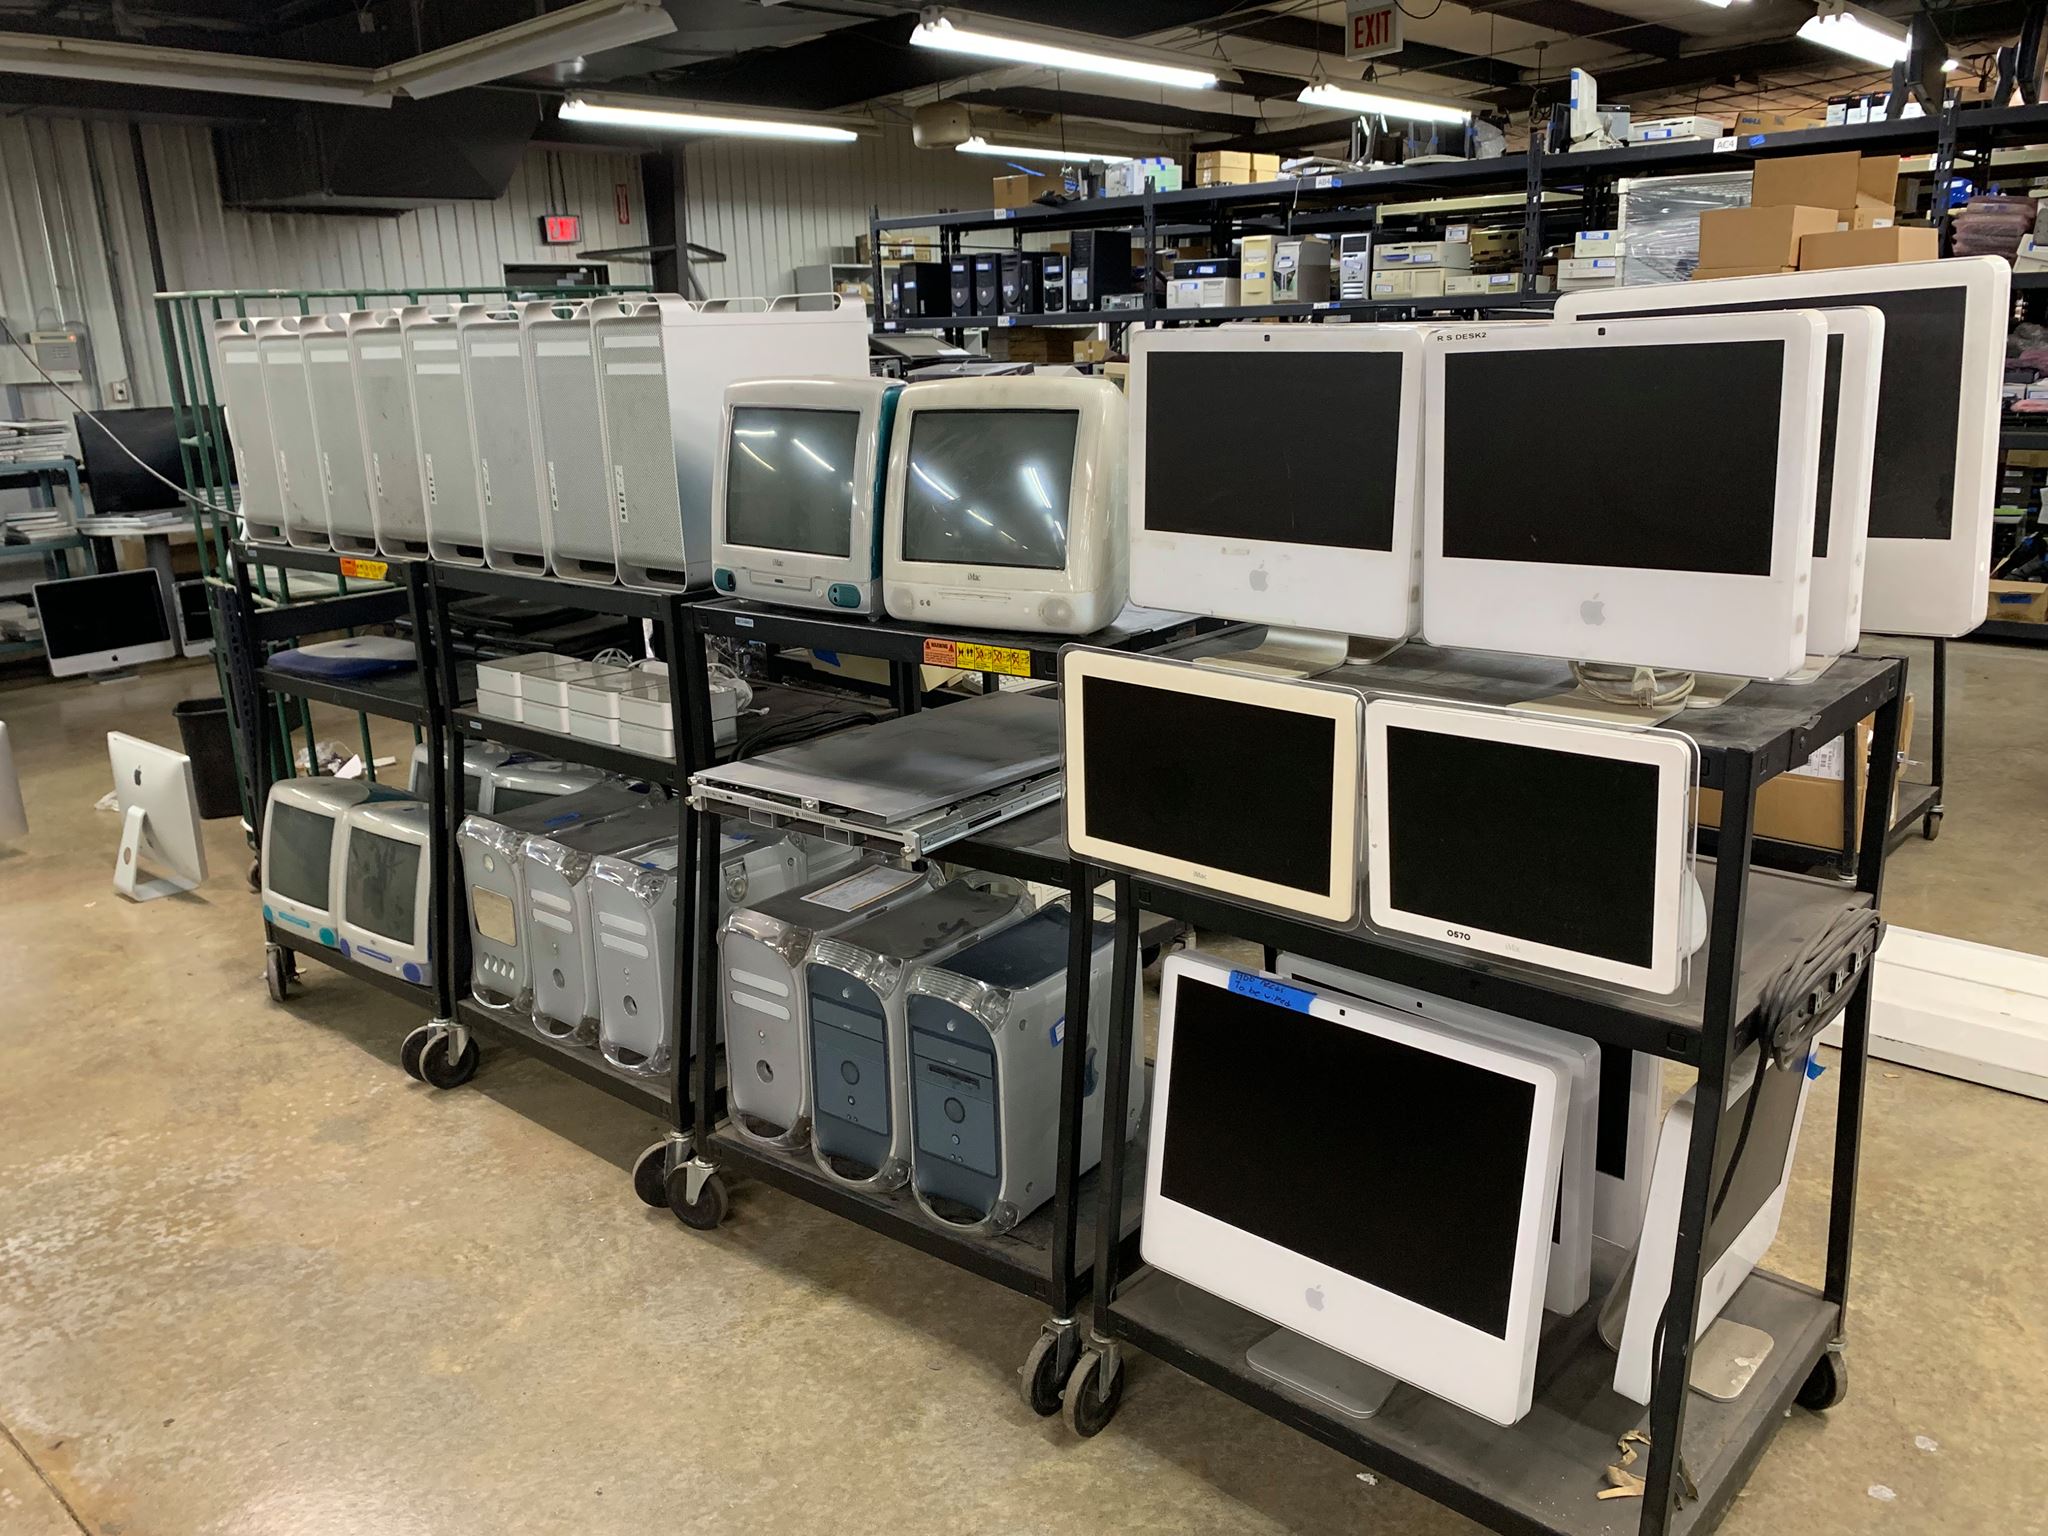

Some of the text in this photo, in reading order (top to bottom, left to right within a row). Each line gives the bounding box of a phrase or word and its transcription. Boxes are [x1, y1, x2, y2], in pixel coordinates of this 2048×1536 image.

[1354, 9, 1392, 49] EXIT
[1717, 139, 1734, 150] AC4
[1455, 332, 1487, 341] DESK2
[967, 572, 981, 582] iMac
[1234, 980, 1246, 991] To
[1248, 986, 1261, 997] be
